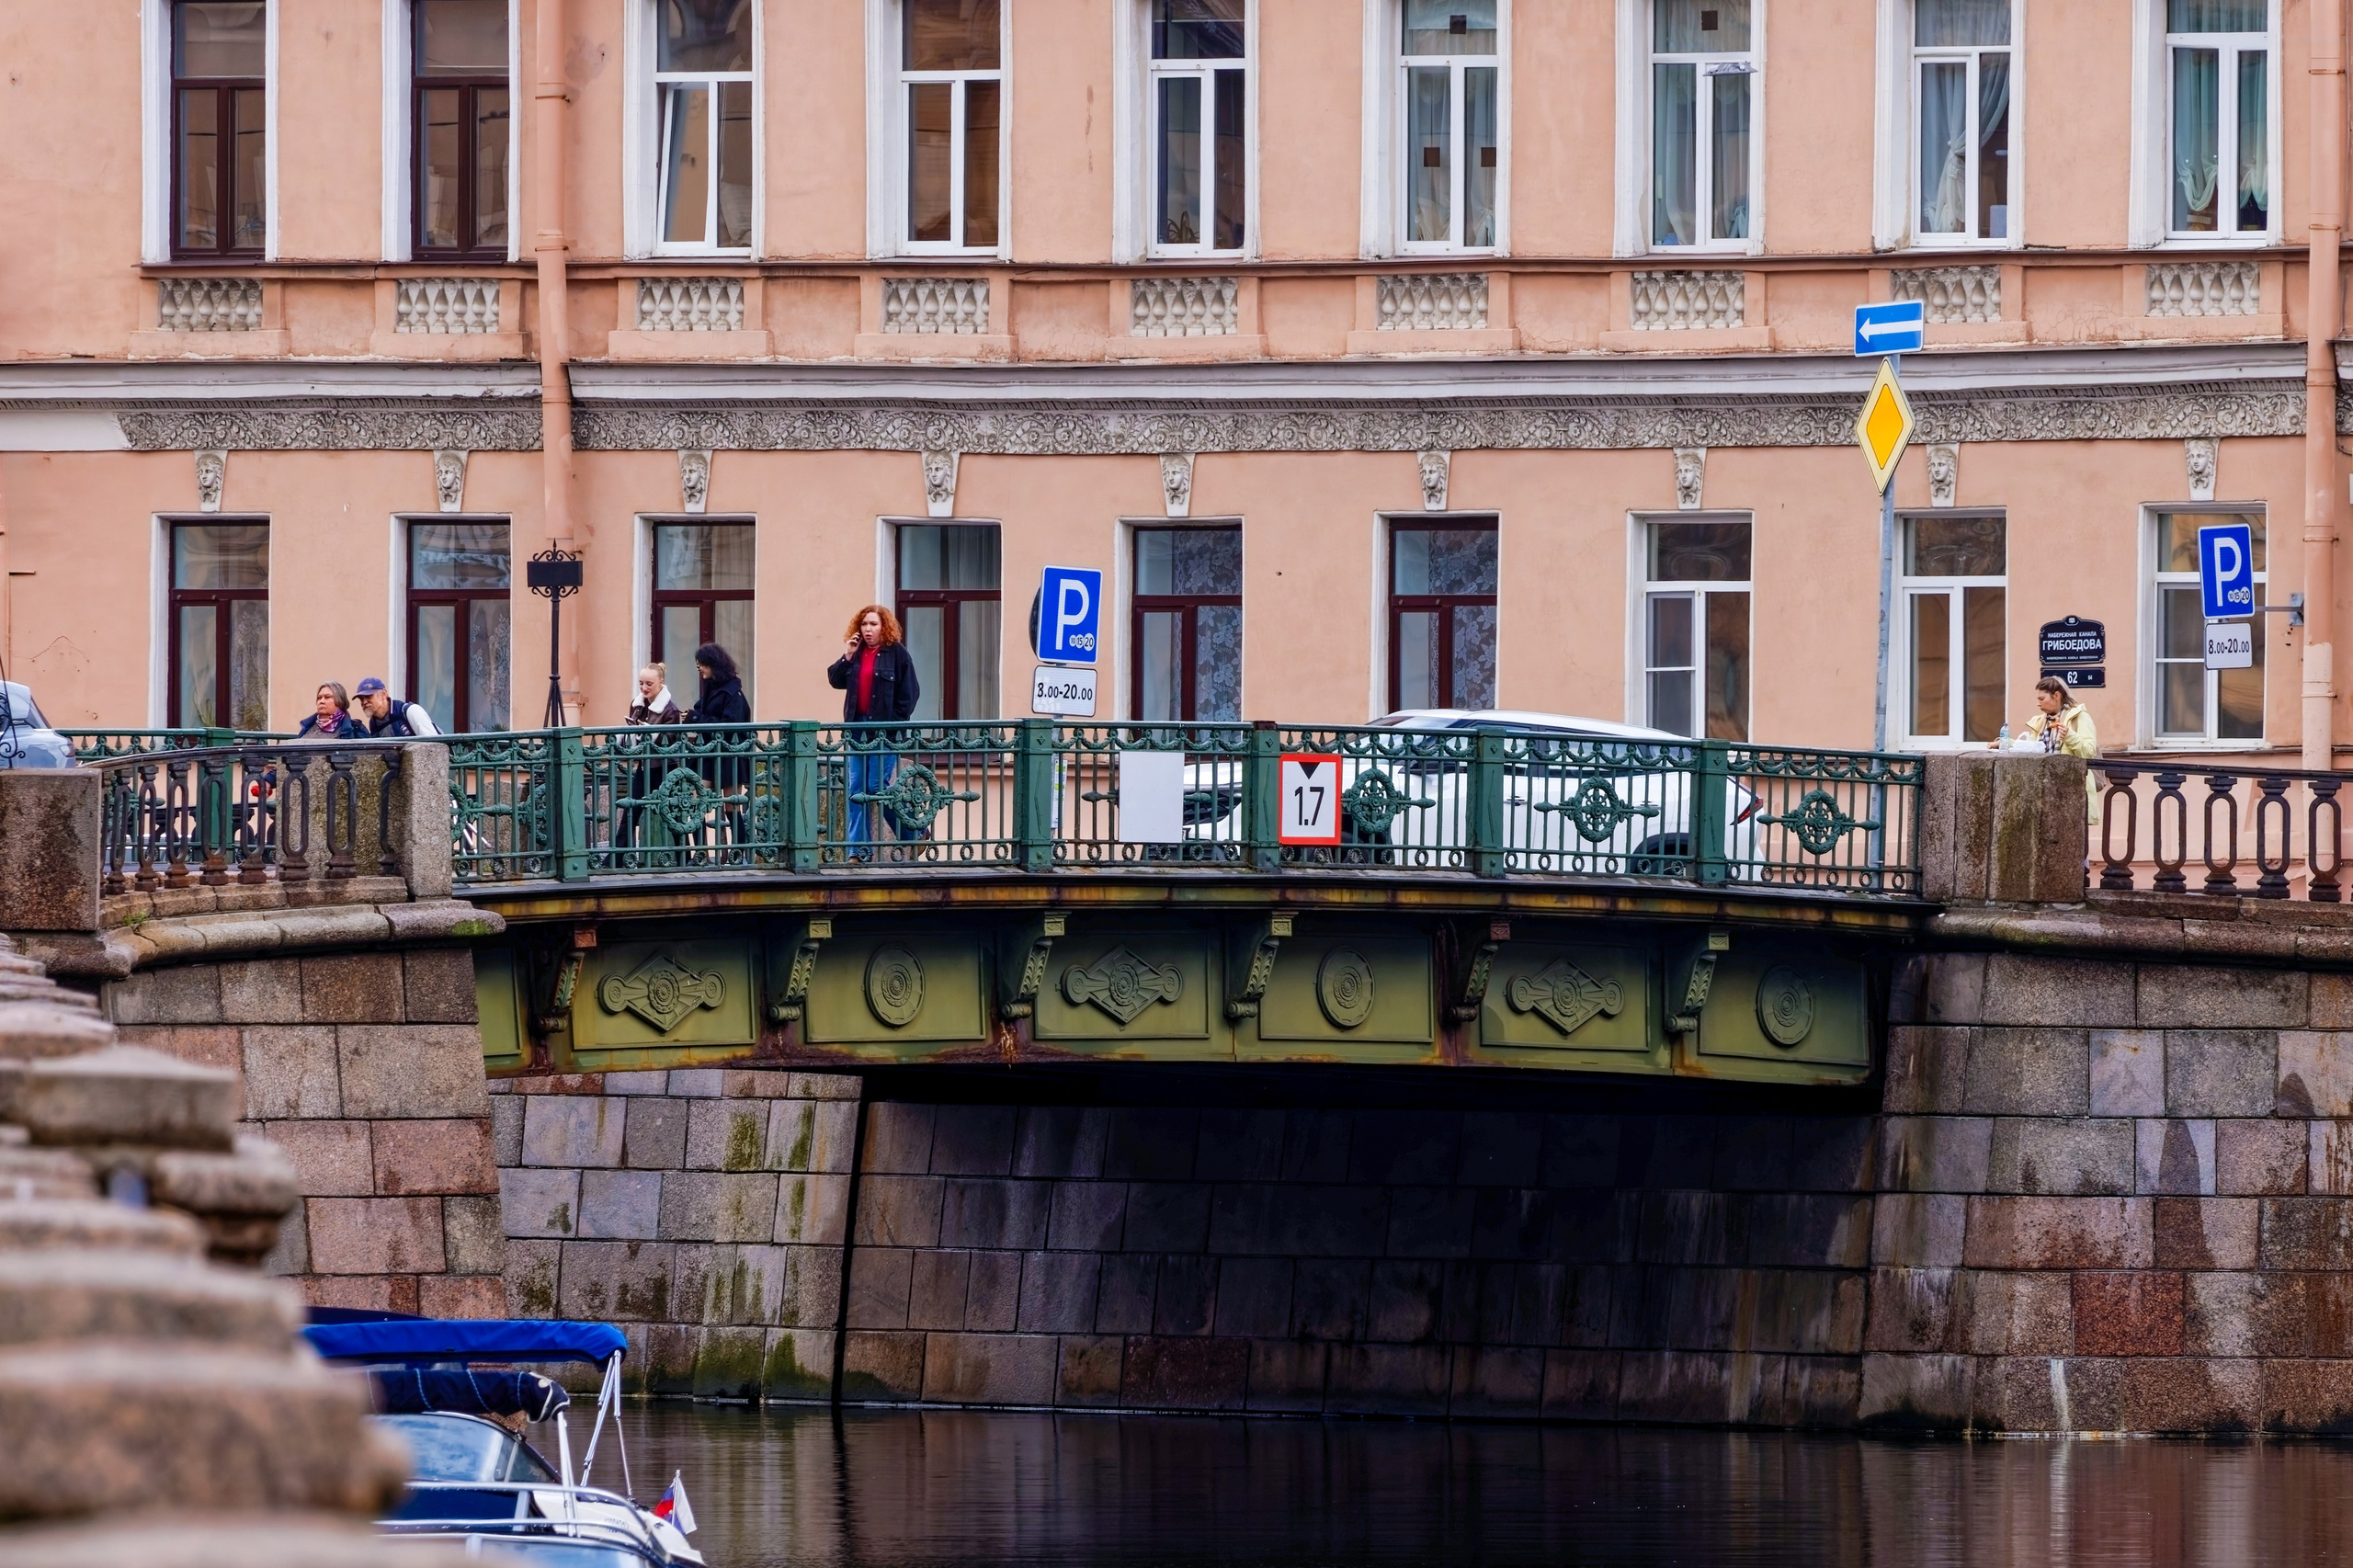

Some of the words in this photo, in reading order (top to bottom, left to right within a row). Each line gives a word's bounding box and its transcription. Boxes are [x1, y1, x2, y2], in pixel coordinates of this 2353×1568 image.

[2213, 537, 2243, 608] P
[2241, 590, 2249, 601] 20
[1055, 578, 1090, 651] P
[1085, 636, 1094, 647] 20
[2042, 639, 2102, 652] ГРИБОЕДОВА
[2208, 638, 2250, 654] 8.00-20.00
[2067, 671, 2078, 684] 62
[1037, 682, 1093, 700] 8.00-20.00
[1294, 786, 1325, 826] 1.7
